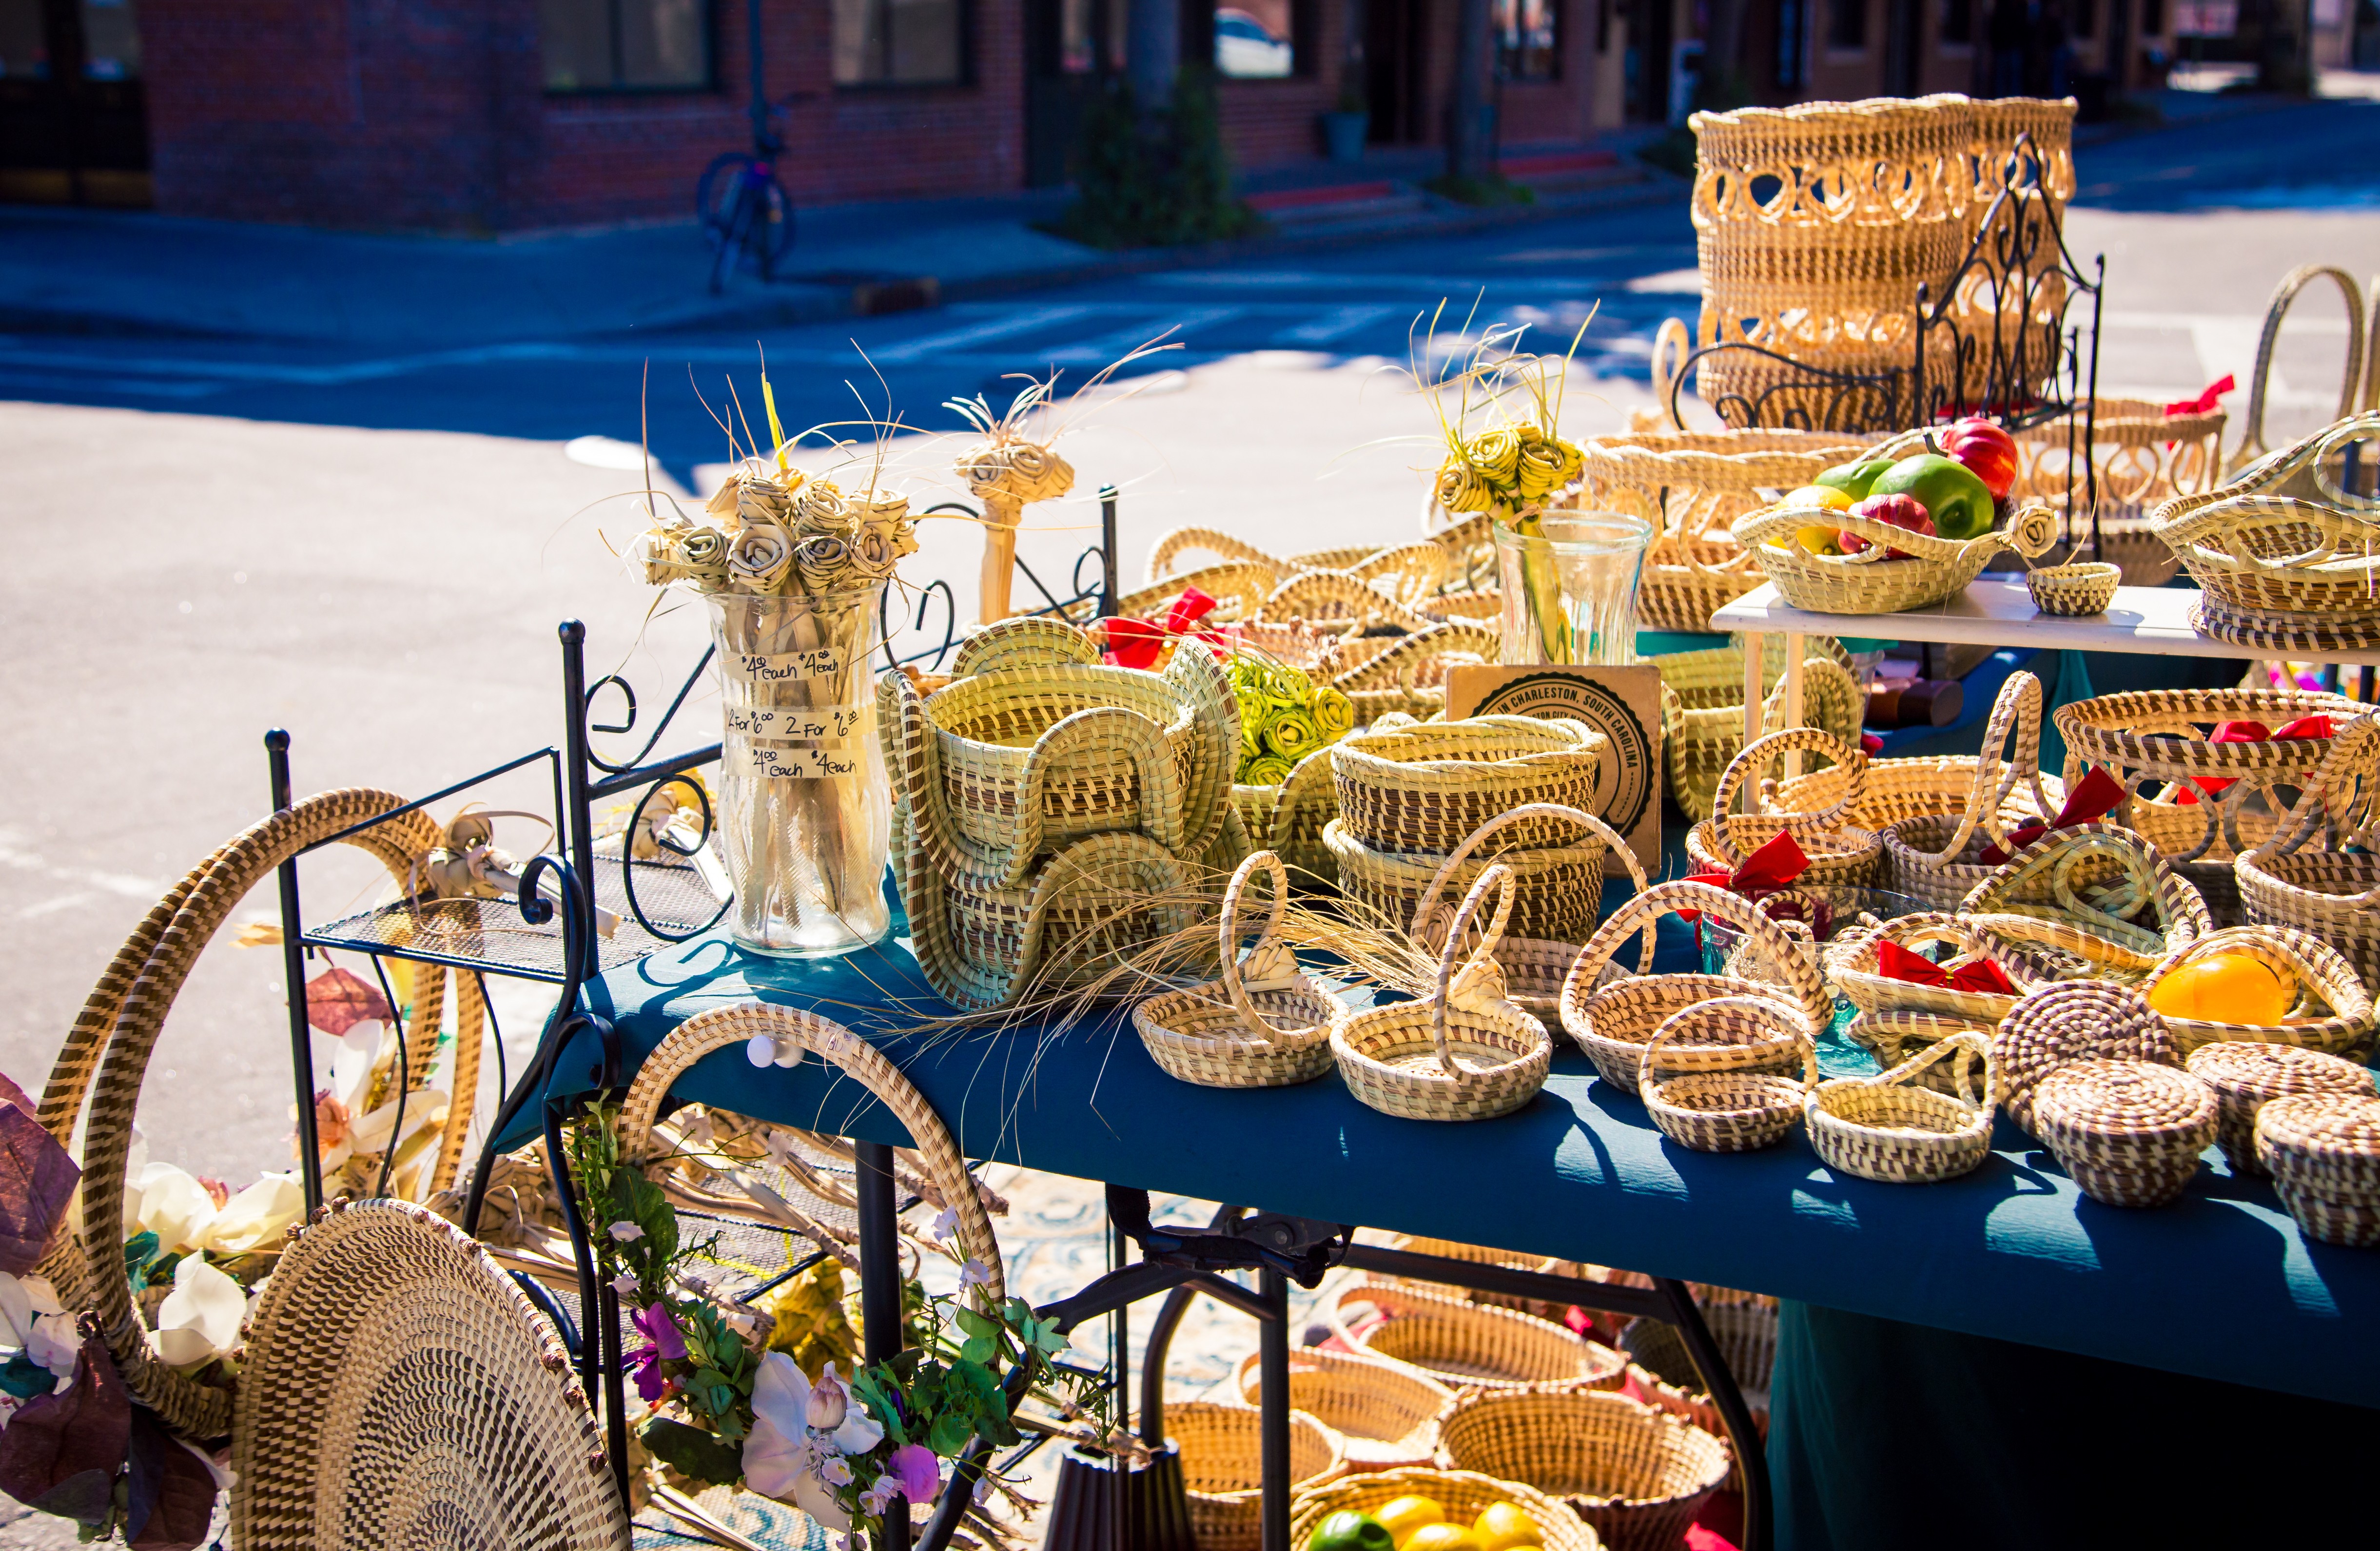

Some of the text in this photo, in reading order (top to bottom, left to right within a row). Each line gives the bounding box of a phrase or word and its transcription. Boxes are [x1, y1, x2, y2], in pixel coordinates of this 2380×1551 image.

[762, 664, 797, 680] each
[817, 659, 839, 673] each
[728, 708, 734, 727] 2
[735, 717, 750, 731] For
[785, 716, 801, 734] 2
[803, 723, 827, 738] For
[1498, 687, 1638, 768] IN CHARLESTON, SOUTH CAROLINA
[770, 763, 803, 778] each
[826, 760, 857, 775] each
